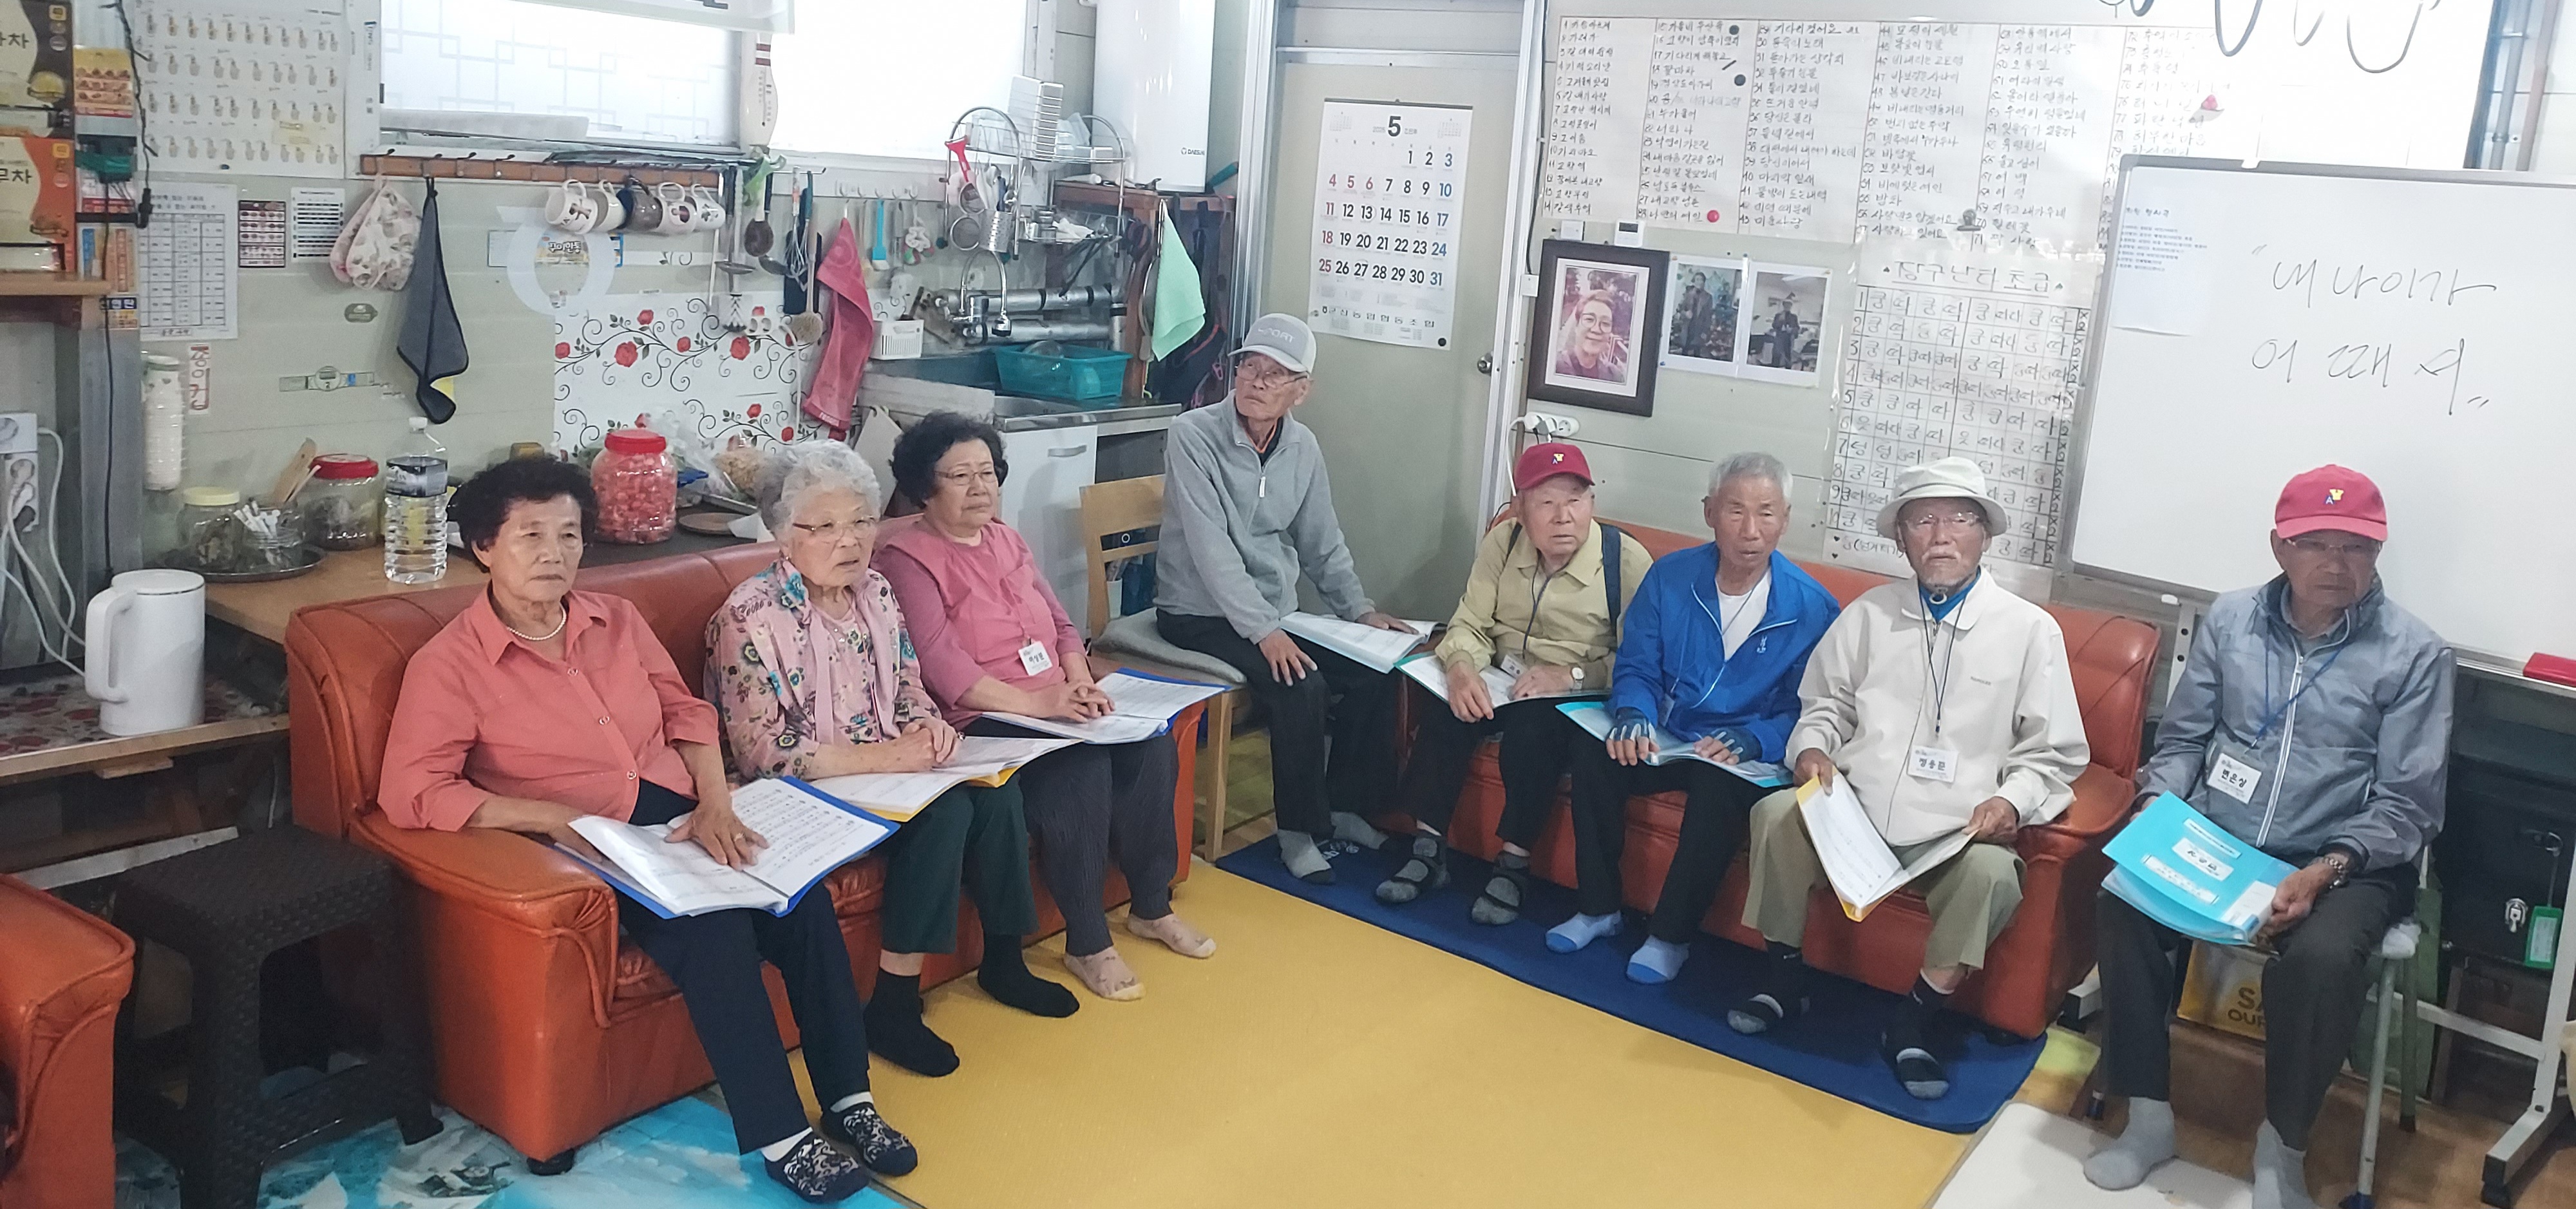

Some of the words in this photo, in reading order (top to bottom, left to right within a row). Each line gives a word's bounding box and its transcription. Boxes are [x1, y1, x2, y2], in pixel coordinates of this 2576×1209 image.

[1388, 115, 1401, 137] 5
[1408, 150, 1412, 164] 1
[1425, 151, 1433, 166] 2
[1444, 153, 1453, 167] 3
[1329, 174, 1336, 187] 4
[1347, 175, 1354, 189] 5
[1366, 176, 1374, 190] 6
[1385, 178, 1393, 192] 7
[1403, 180, 1412, 194] 8
[1422, 181, 1430, 195] 9
[1439, 182, 1452, 197] 10
[1326, 202, 1334, 216] 11
[1343, 204, 1354, 218] 12
[1361, 205, 1373, 220] 13
[1380, 207, 1392, 222] 14
[1399, 209, 1411, 224] 15
[1417, 211, 1430, 225] 16
[1437, 213, 1449, 227] 17
[1322, 230, 1334, 244] 18
[1340, 232, 1352, 246] 19
[1356, 234, 1371, 249] 20
[1376, 236, 1388, 251] 21
[1394, 238, 1409, 252] 22
[1412, 240, 1427, 255] 23
[1431, 242, 1447, 257] 24
[1318, 258, 1332, 273] 25
[1335, 260, 1350, 275] 26
[1353, 262, 1368, 277] 27
[1372, 265, 1387, 280] 28
[1390, 267, 1406, 281] 29
[1409, 269, 1425, 284] 30
[1430, 271, 1443, 287] 31
[1853, 317, 1861, 332] 2
[1851, 340, 1858, 355] 3
[1844, 390, 1854, 403] 5
[1839, 439, 1847, 453] 7
[1833, 464, 1842, 477] 8
[1832, 485, 1840, 499] 9
